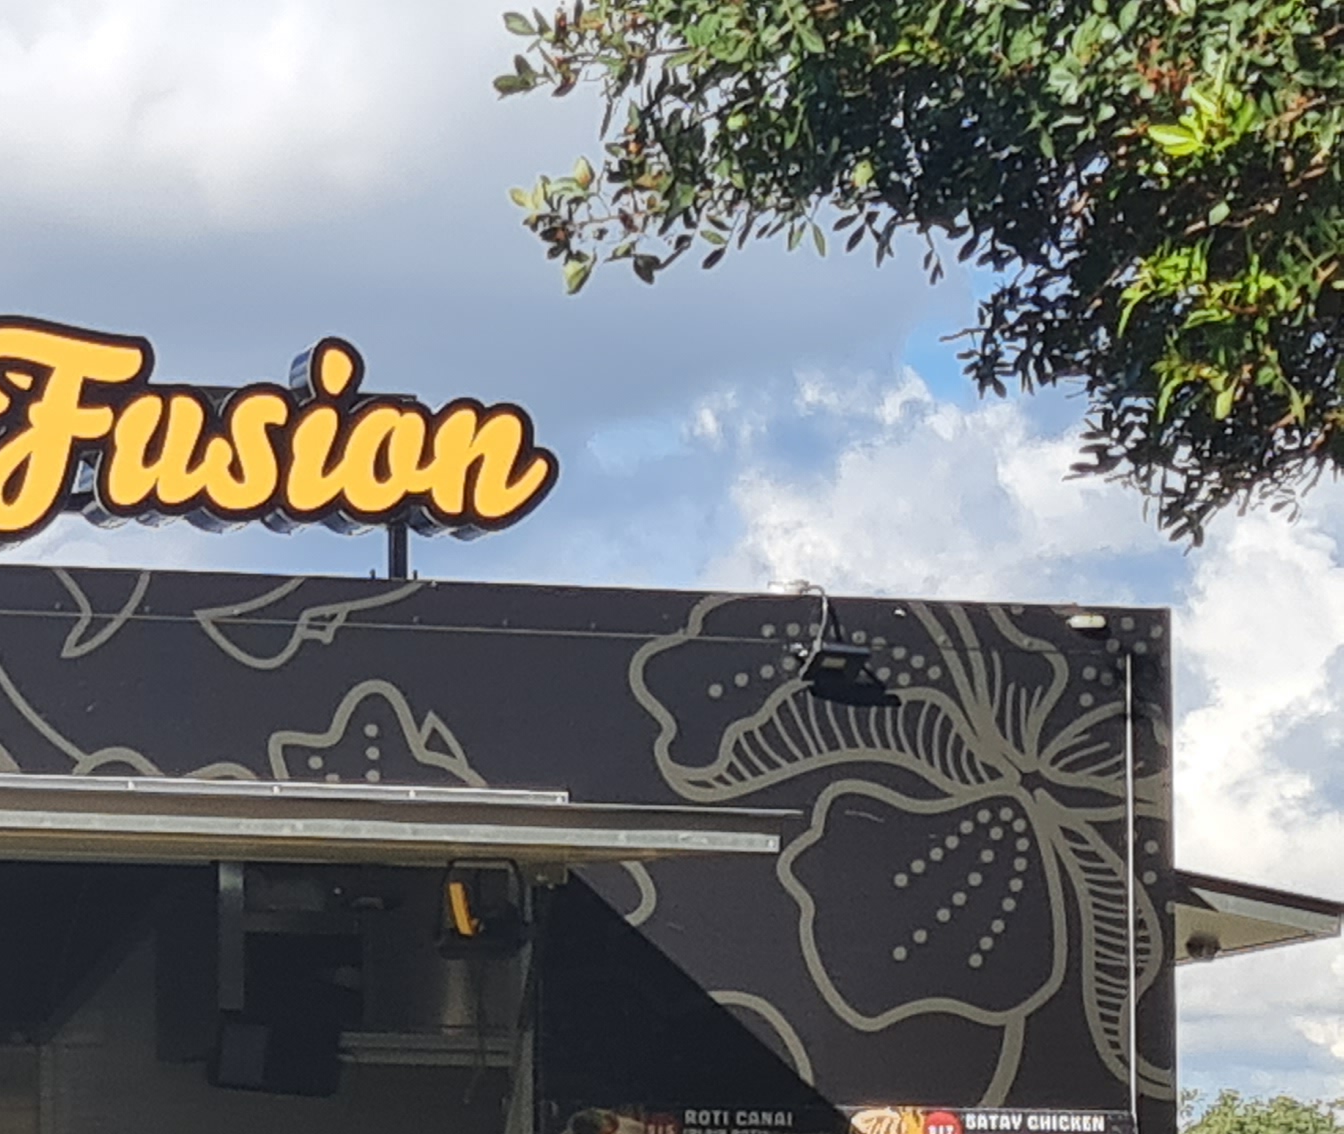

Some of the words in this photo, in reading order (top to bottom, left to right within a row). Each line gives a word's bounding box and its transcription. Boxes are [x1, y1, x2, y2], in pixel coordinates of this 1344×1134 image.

[684, 1110, 728, 1126] ROTI
[734, 1110, 793, 1127] CANAI
[964, 1113, 1023, 1131] SATAY
[1027, 1114, 1106, 1132] CHICKEN
